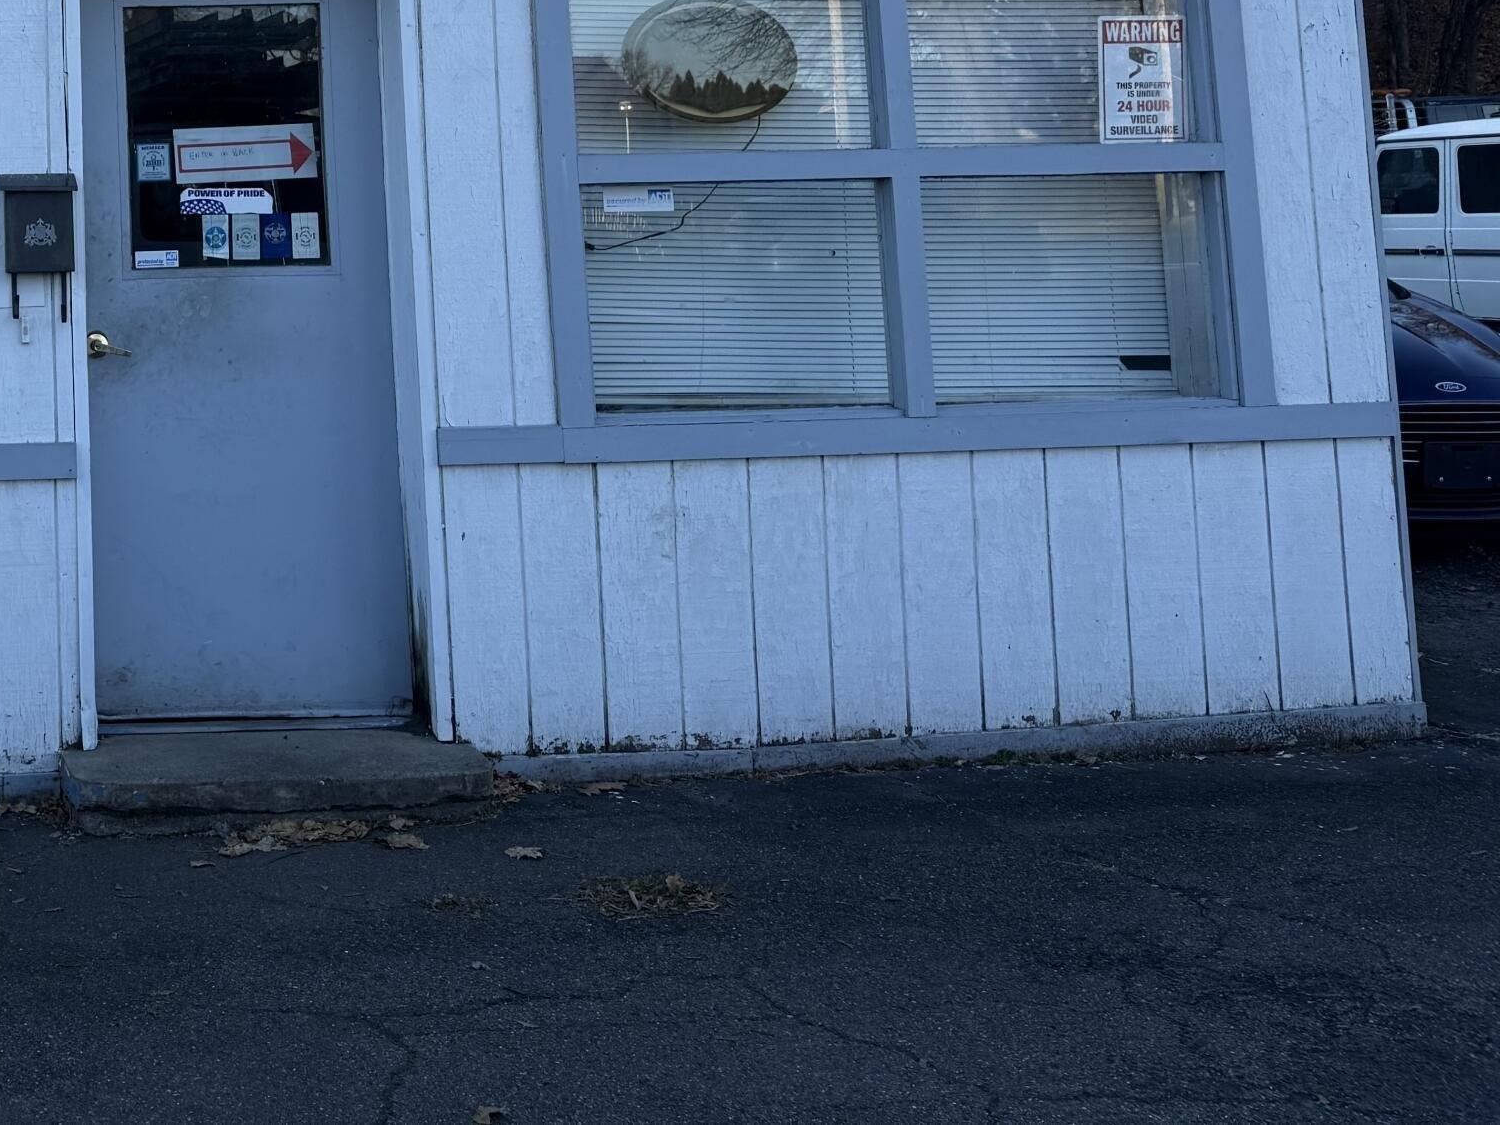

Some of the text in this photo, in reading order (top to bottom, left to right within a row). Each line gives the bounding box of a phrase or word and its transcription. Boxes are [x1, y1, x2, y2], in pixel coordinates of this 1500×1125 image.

[1105, 20, 1181, 42] WARNING
[1116, 81, 1171, 90] THIS PROPERTY
[1127, 89, 1161, 98] IS UNDER
[1117, 100, 1170, 113] 24 HOUR
[1130, 114, 1158, 124] VIDEO
[1110, 125, 1180, 136] SURVEILLANCE
[187, 188, 266, 197] POWER OF PRIDE
[649, 191, 670, 204] ADT
